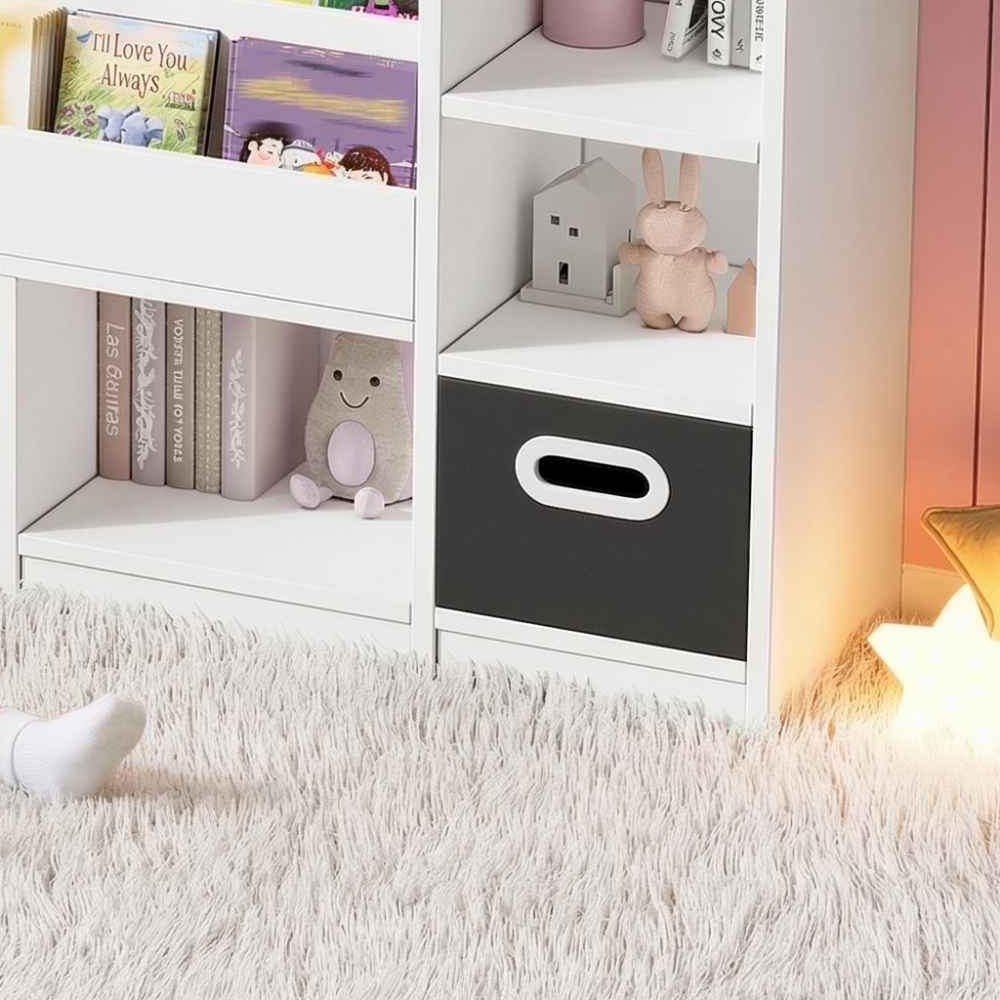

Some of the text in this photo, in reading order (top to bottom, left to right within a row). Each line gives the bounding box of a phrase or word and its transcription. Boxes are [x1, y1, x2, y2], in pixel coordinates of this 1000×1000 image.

[113, 32, 154, 62] Love
[157, 43, 188, 72] You
[100, 63, 160, 99] Always
[105, 322, 126, 358] Las
